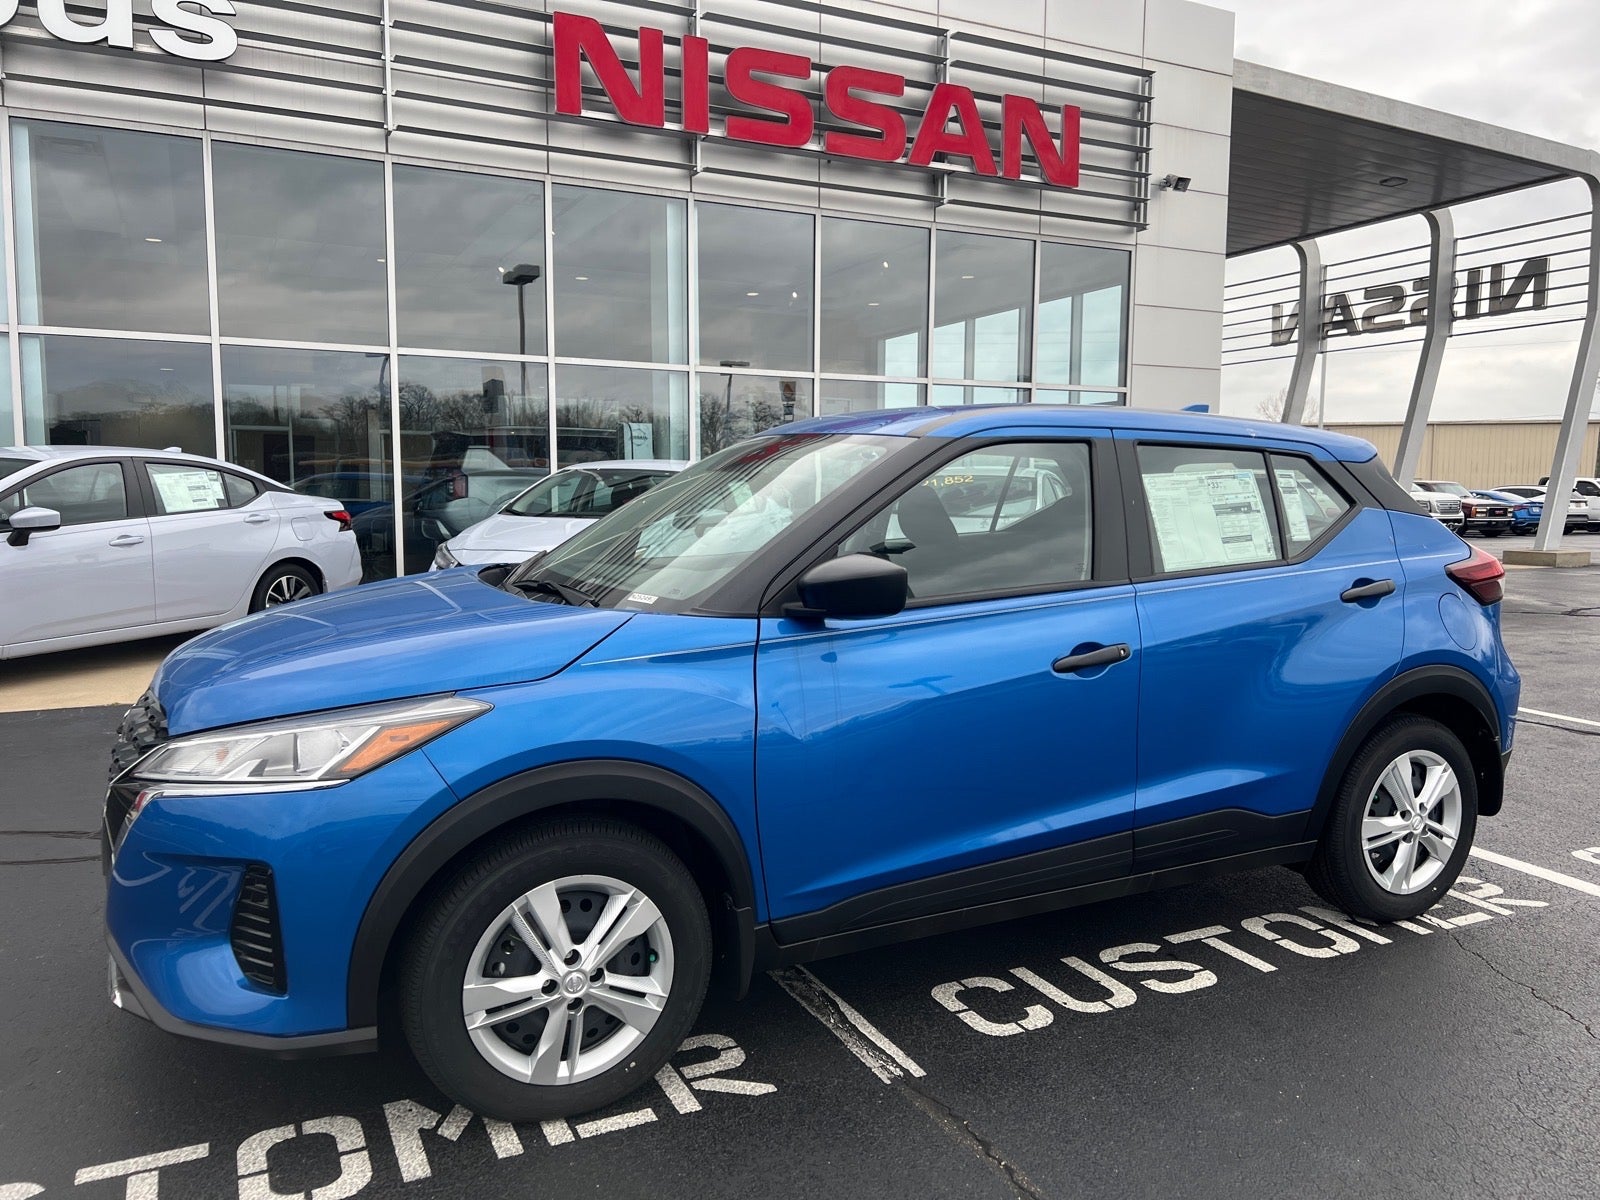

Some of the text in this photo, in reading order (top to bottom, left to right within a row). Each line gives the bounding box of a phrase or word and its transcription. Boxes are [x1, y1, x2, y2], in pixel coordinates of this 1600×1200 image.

[0, 0, 238, 61] us
[553, 11, 1080, 188] NISSAN
[0, 1034, 777, 1200] TOMR
